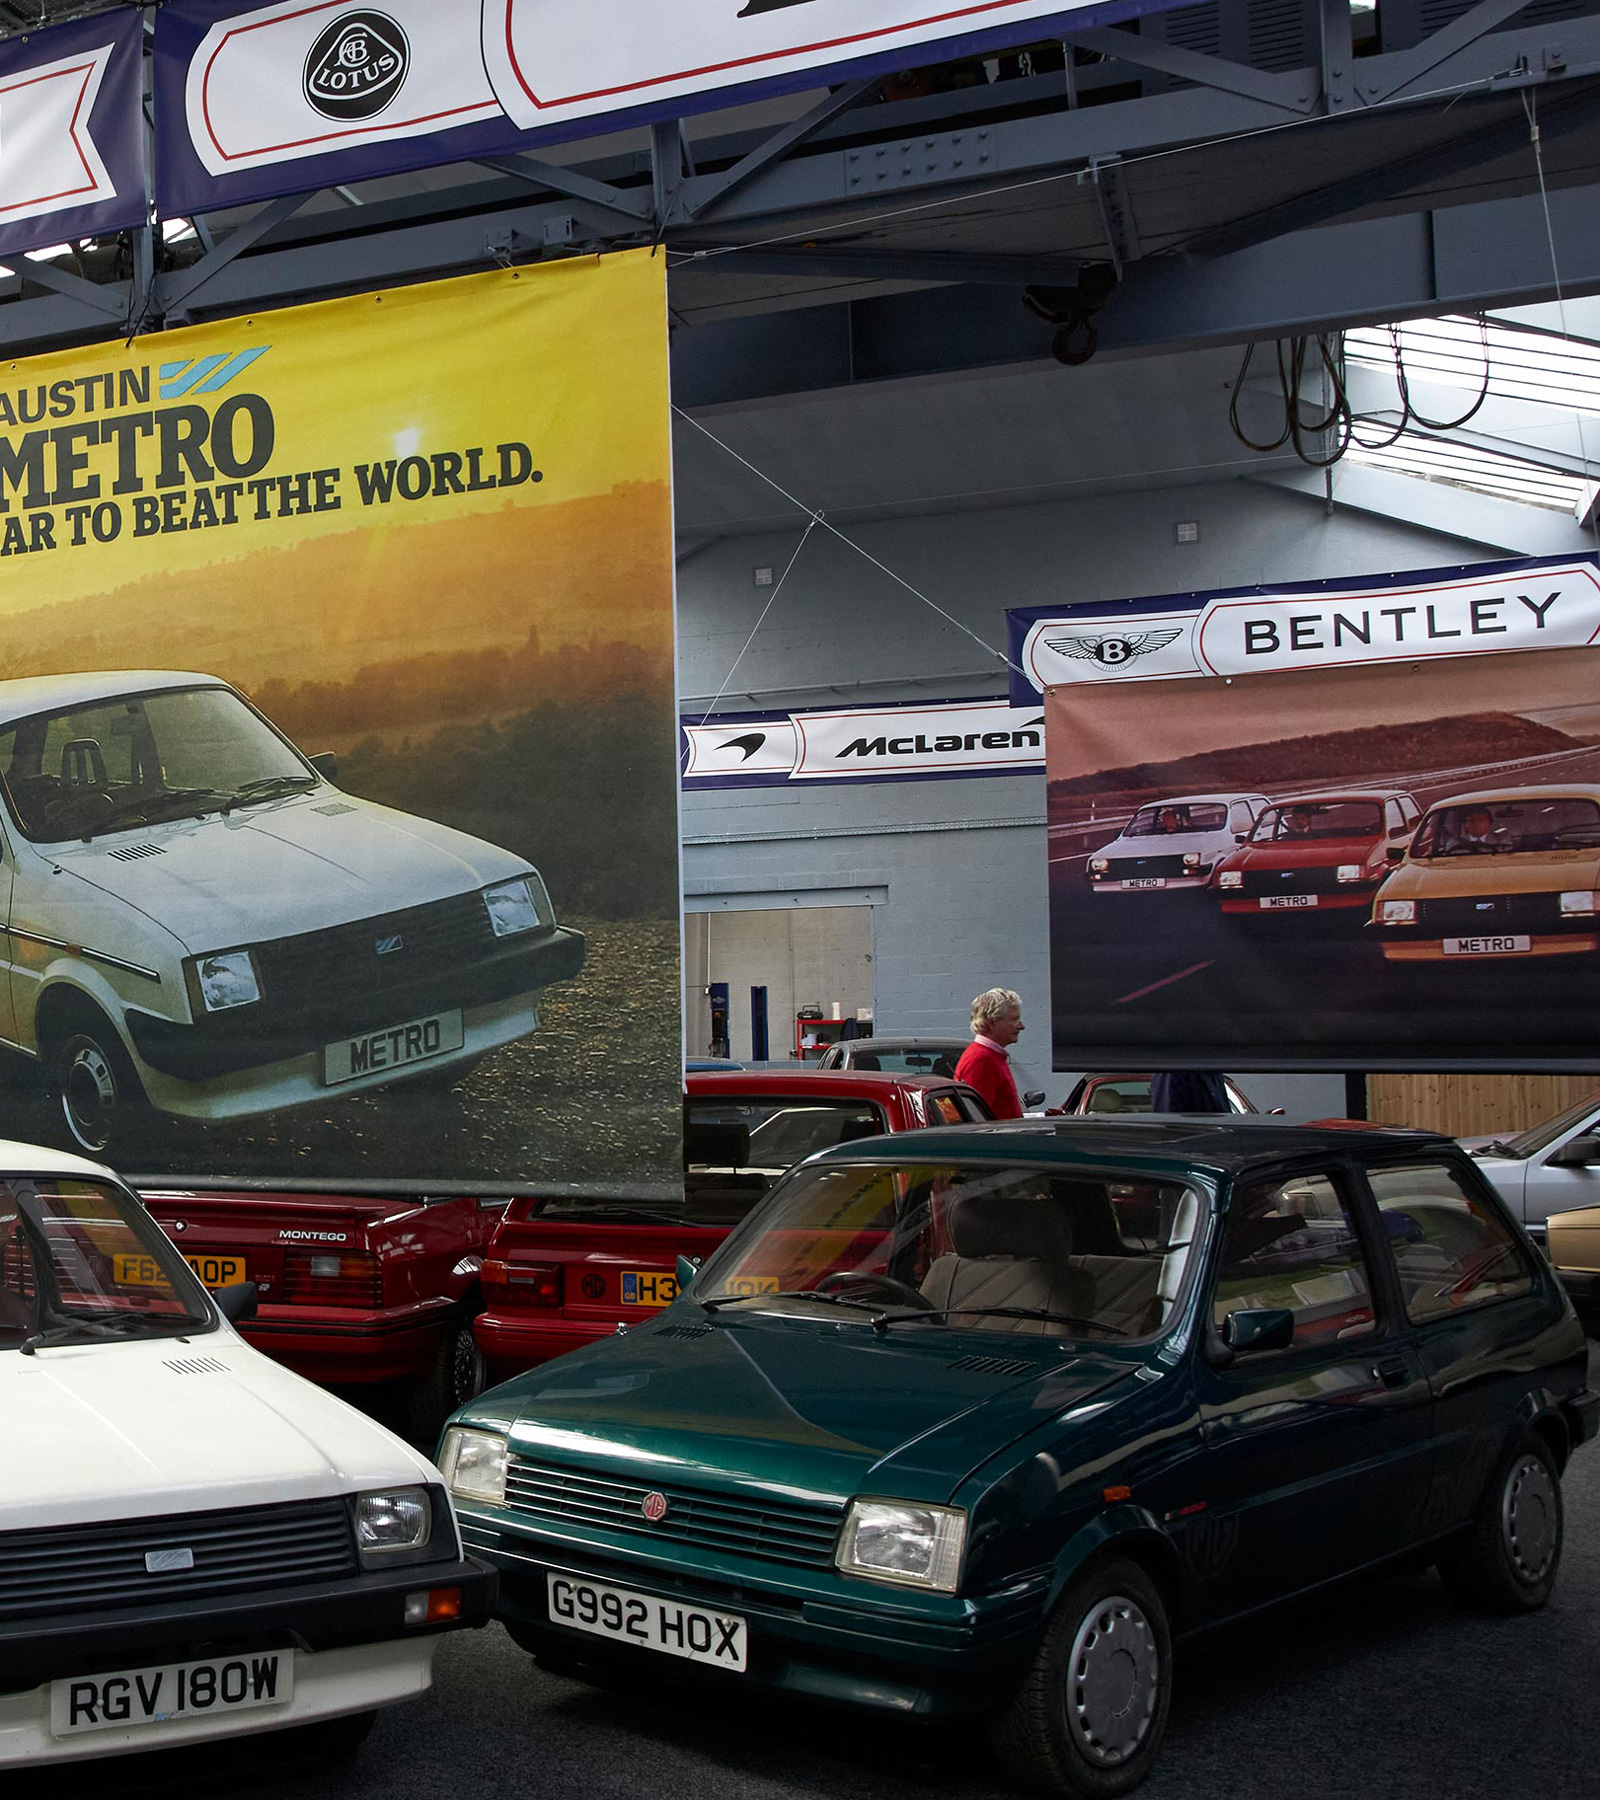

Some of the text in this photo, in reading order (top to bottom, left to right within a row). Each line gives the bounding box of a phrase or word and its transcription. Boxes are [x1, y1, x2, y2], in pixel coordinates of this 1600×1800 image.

[317, 53, 395, 89] LOTUS
[65, 501, 122, 546] TO
[132, 485, 243, 538] BEAT
[246, 467, 341, 520] THE
[353, 441, 544, 506] WORLD.
[1244, 592, 1562, 655] BENTLEY
[835, 730, 1040, 758] McLaren
[1129, 879, 1157, 888] METRO
[1270, 896, 1308, 907] METRO
[1458, 938, 1515, 952] METRO
[350, 1018, 440, 1074] METRO
[279, 1229, 347, 1241] MONTEGO
[553, 1579, 740, 1661] G992 HOX
[70, 1656, 278, 1726] RGV 180W
